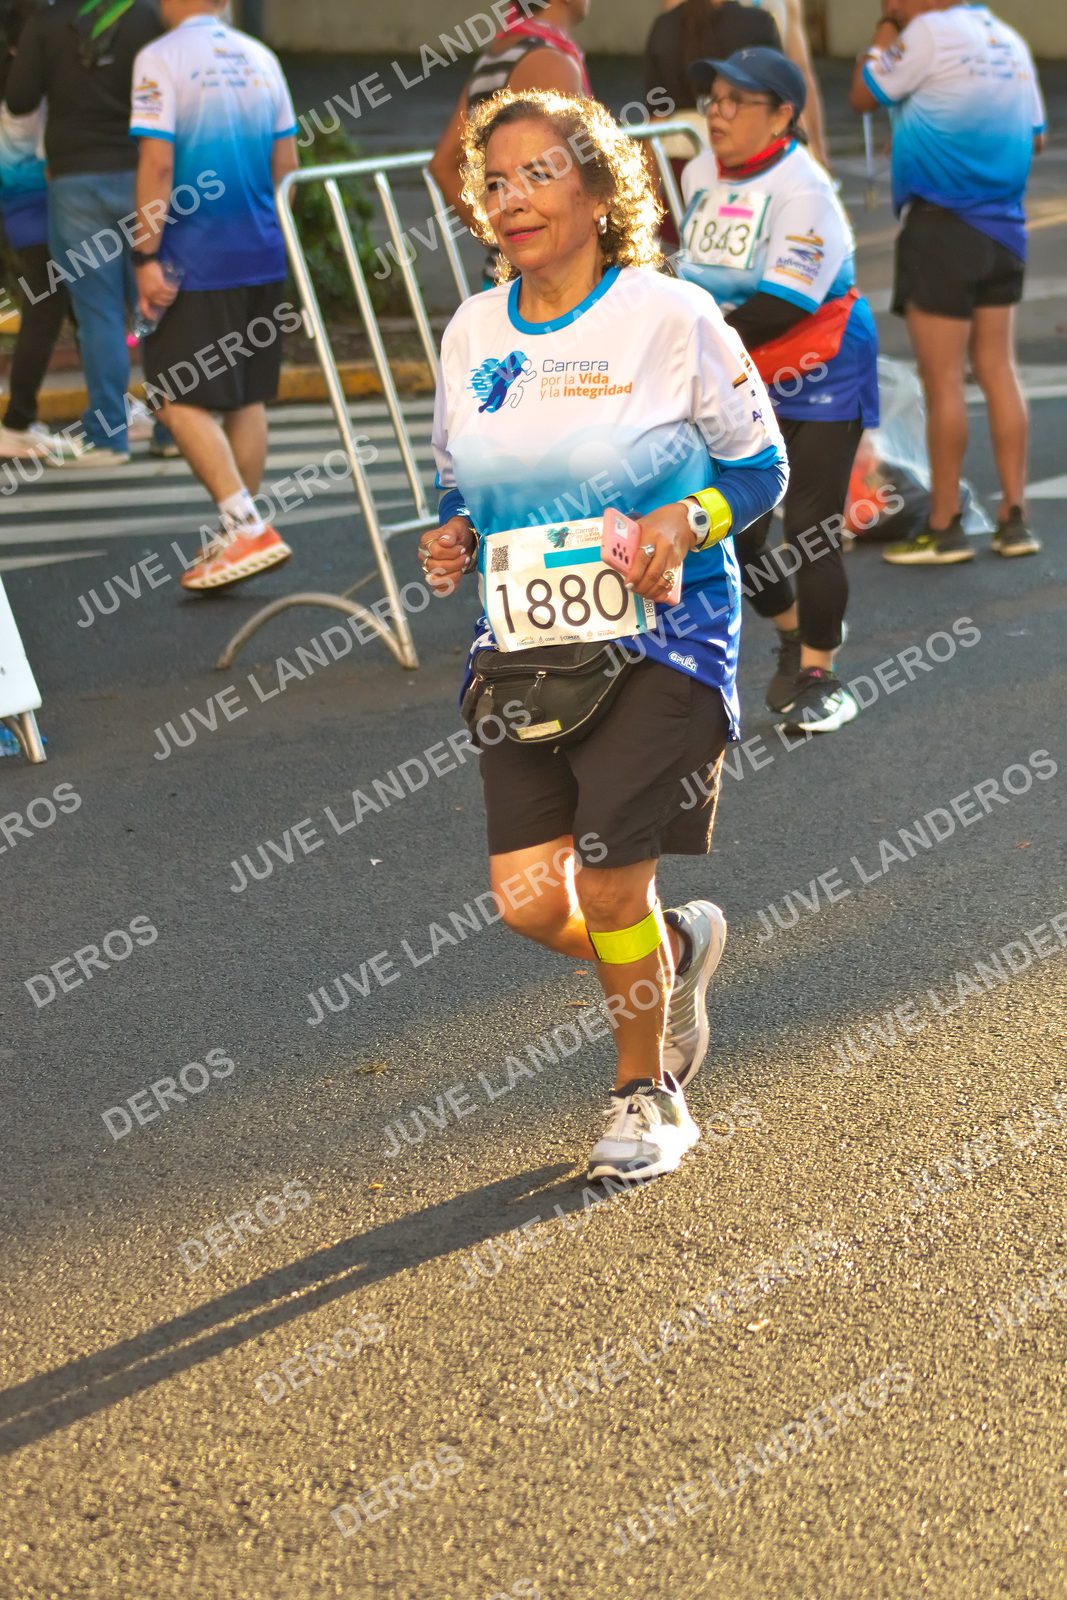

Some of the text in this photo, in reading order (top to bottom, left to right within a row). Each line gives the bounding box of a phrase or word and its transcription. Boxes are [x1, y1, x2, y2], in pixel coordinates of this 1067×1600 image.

[688, 220, 750, 256] 1843
[542, 359, 609, 373] Carrera
[541, 373, 609, 388] por la Vida
[540, 382, 633, 400] y la Integridad
[496, 568, 629, 633] 1880
